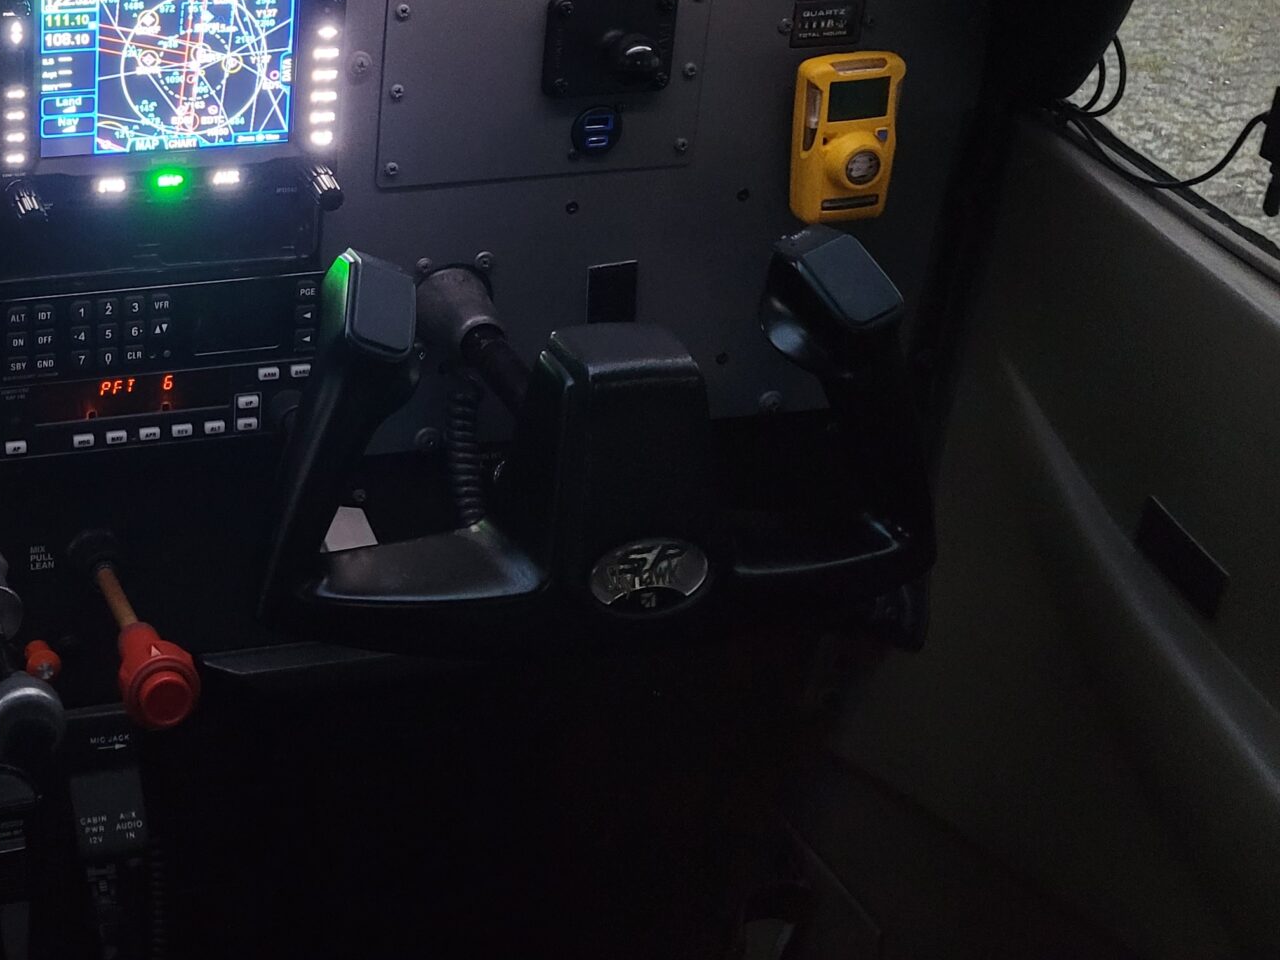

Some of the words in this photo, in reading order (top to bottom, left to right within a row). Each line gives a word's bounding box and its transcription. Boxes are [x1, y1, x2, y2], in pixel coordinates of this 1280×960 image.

[803, 9, 846, 17] QUARTZ
[45, 15, 90, 27] 111.10
[283, 59, 292, 81] DATA
[56, 98, 82, 106] Land
[136, 140, 159, 150] MAP
[155, 301, 169, 309] VFR
[11, 314, 25, 323] ALT
[38, 312, 51, 320] IDT
[38, 336, 52, 344] OFF
[128, 352, 142, 360] CLR
[11, 362, 26, 371] SBY
[37, 360, 54, 368] GND
[100, 378, 136, 396] PFT
[30, 546, 45, 554] MIX
[30, 554, 53, 562] PULL
[30, 561, 54, 570] LEAN
[80, 815, 107, 826] CABIN
[85, 825, 104, 833] PWR
[116, 820, 142, 831] AUDIO
